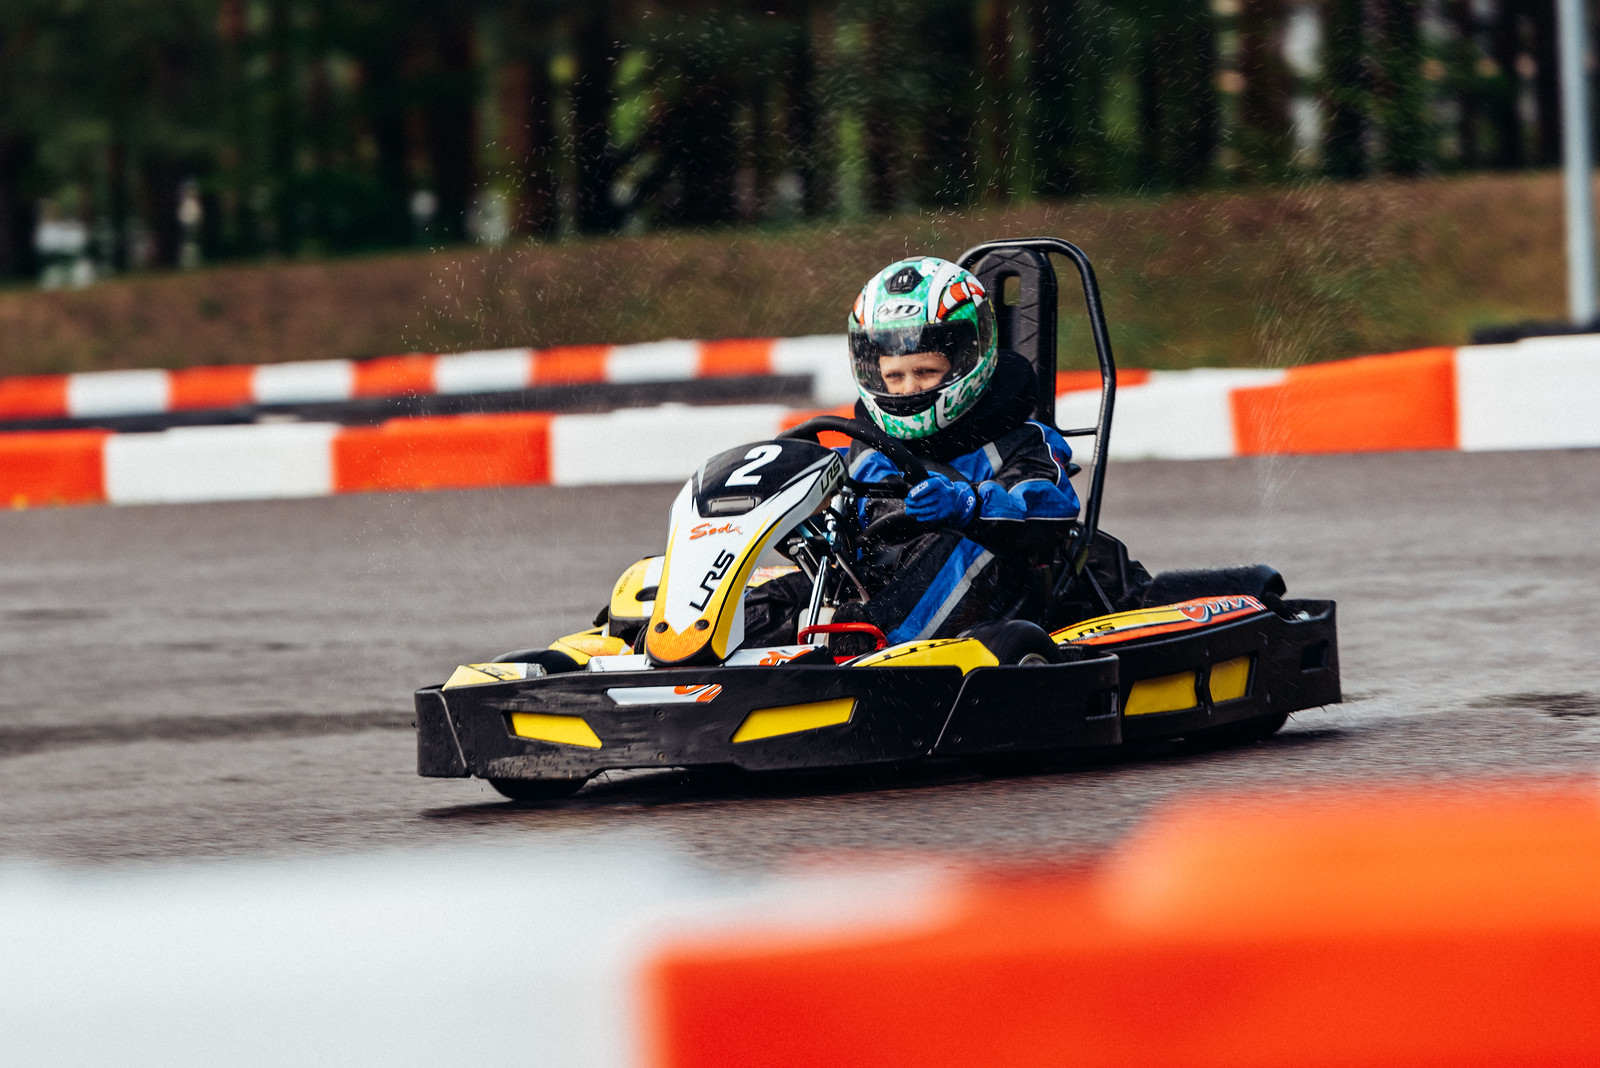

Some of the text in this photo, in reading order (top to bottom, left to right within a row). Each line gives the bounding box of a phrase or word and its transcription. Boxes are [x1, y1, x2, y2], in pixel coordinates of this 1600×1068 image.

[725, 444, 782, 487] 2
[820, 458, 841, 495] LRS
[689, 549, 735, 612] LRS
